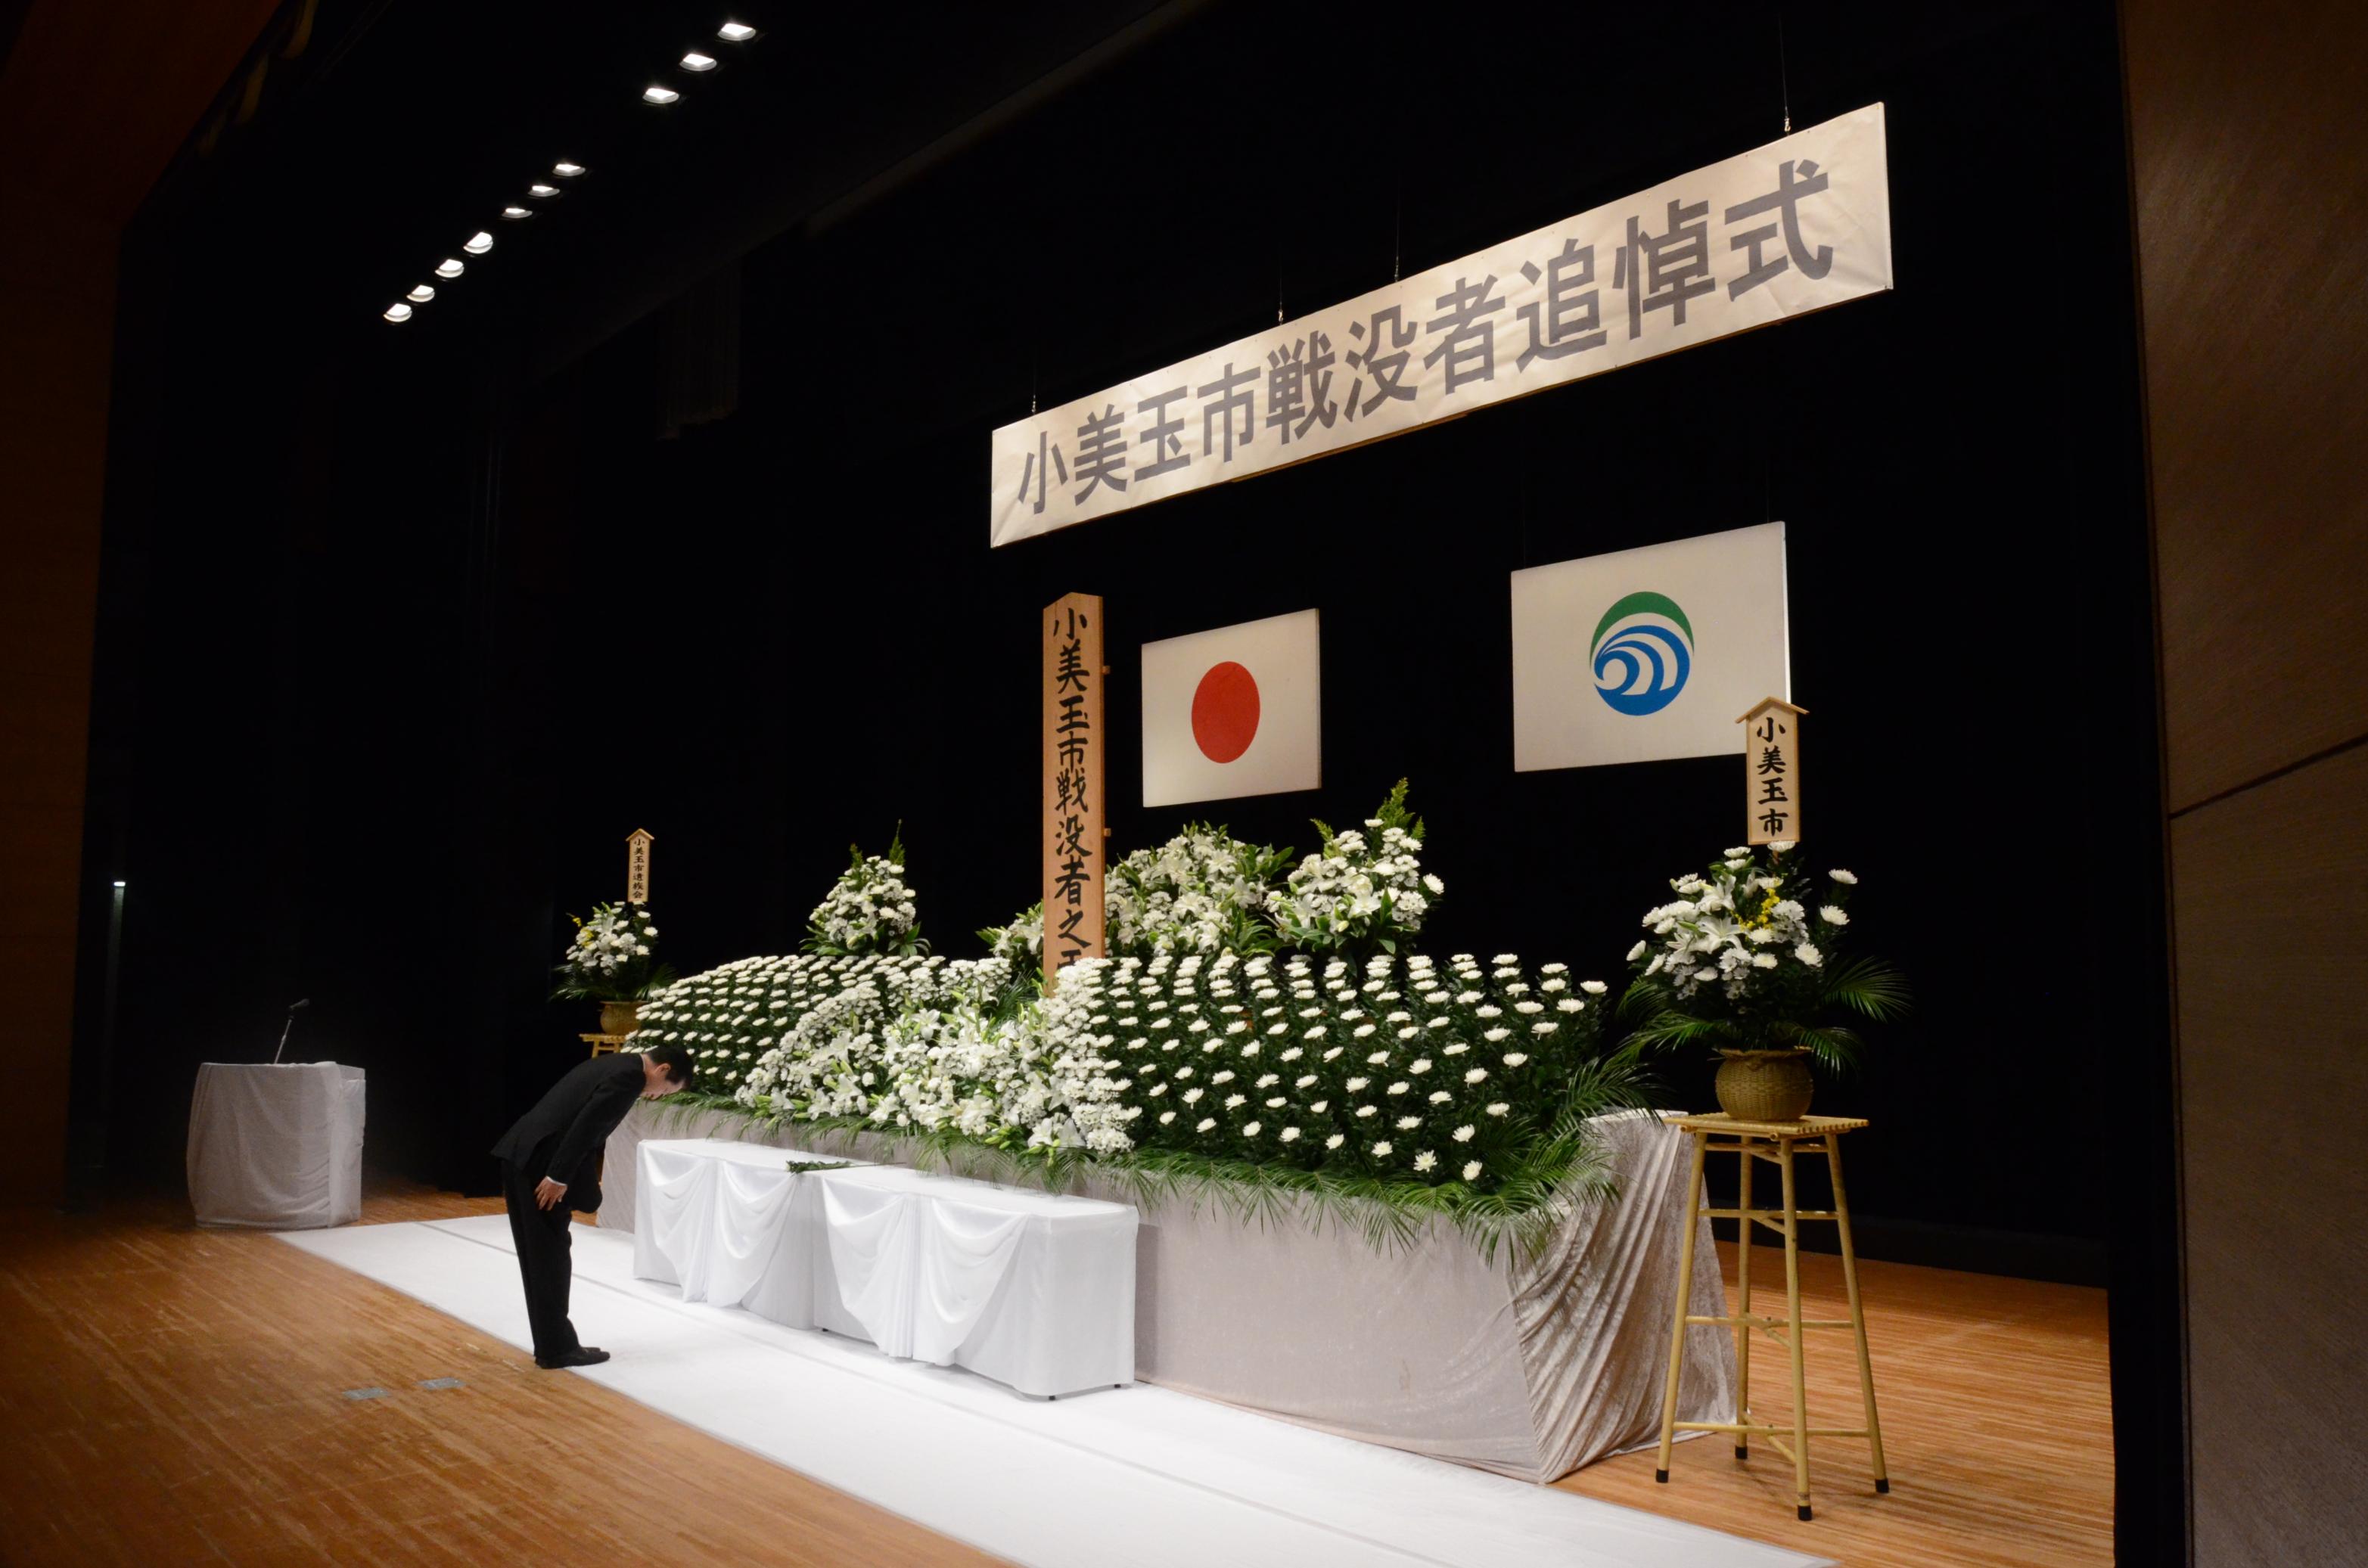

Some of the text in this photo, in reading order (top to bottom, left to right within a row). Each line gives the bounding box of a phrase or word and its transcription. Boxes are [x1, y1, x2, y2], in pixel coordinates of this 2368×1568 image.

[1017, 159, 1835, 514] 小美玉市戦没者追悼式
[632, 838, 645, 899] 小美玉市遺族会
[1053, 607, 1092, 969] 小美玉市戦没者之
[1757, 717, 1788, 837] 小美玉市
